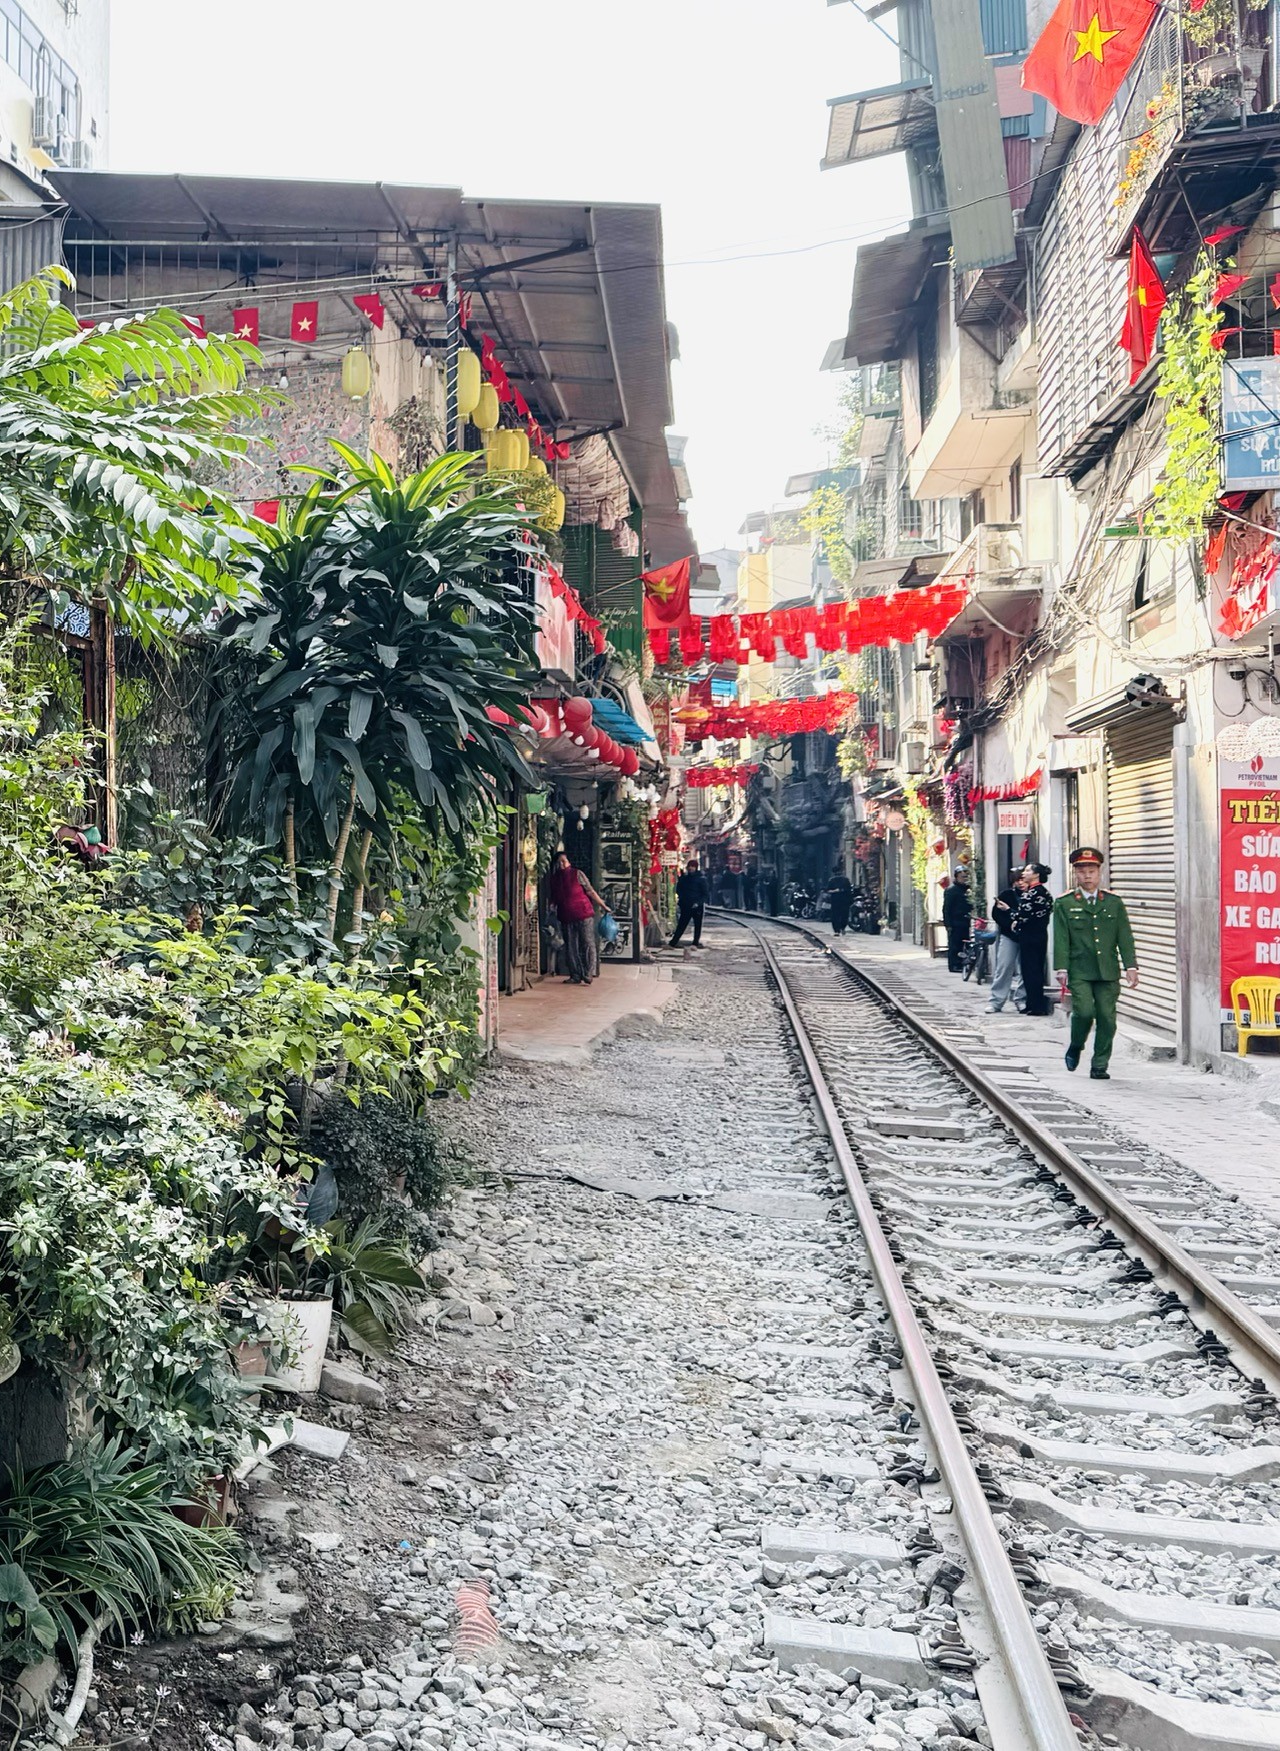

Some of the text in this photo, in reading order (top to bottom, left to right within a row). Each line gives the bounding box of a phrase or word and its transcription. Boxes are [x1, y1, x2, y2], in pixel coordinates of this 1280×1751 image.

[1238, 773, 1278, 781] PETROVIETNAM
[1228, 792, 1280, 824] TIẾ
[1241, 829, 1280, 858] SỬA
[1234, 864, 1277, 894] BẢO
[1225, 905, 1280, 929] XE GA
